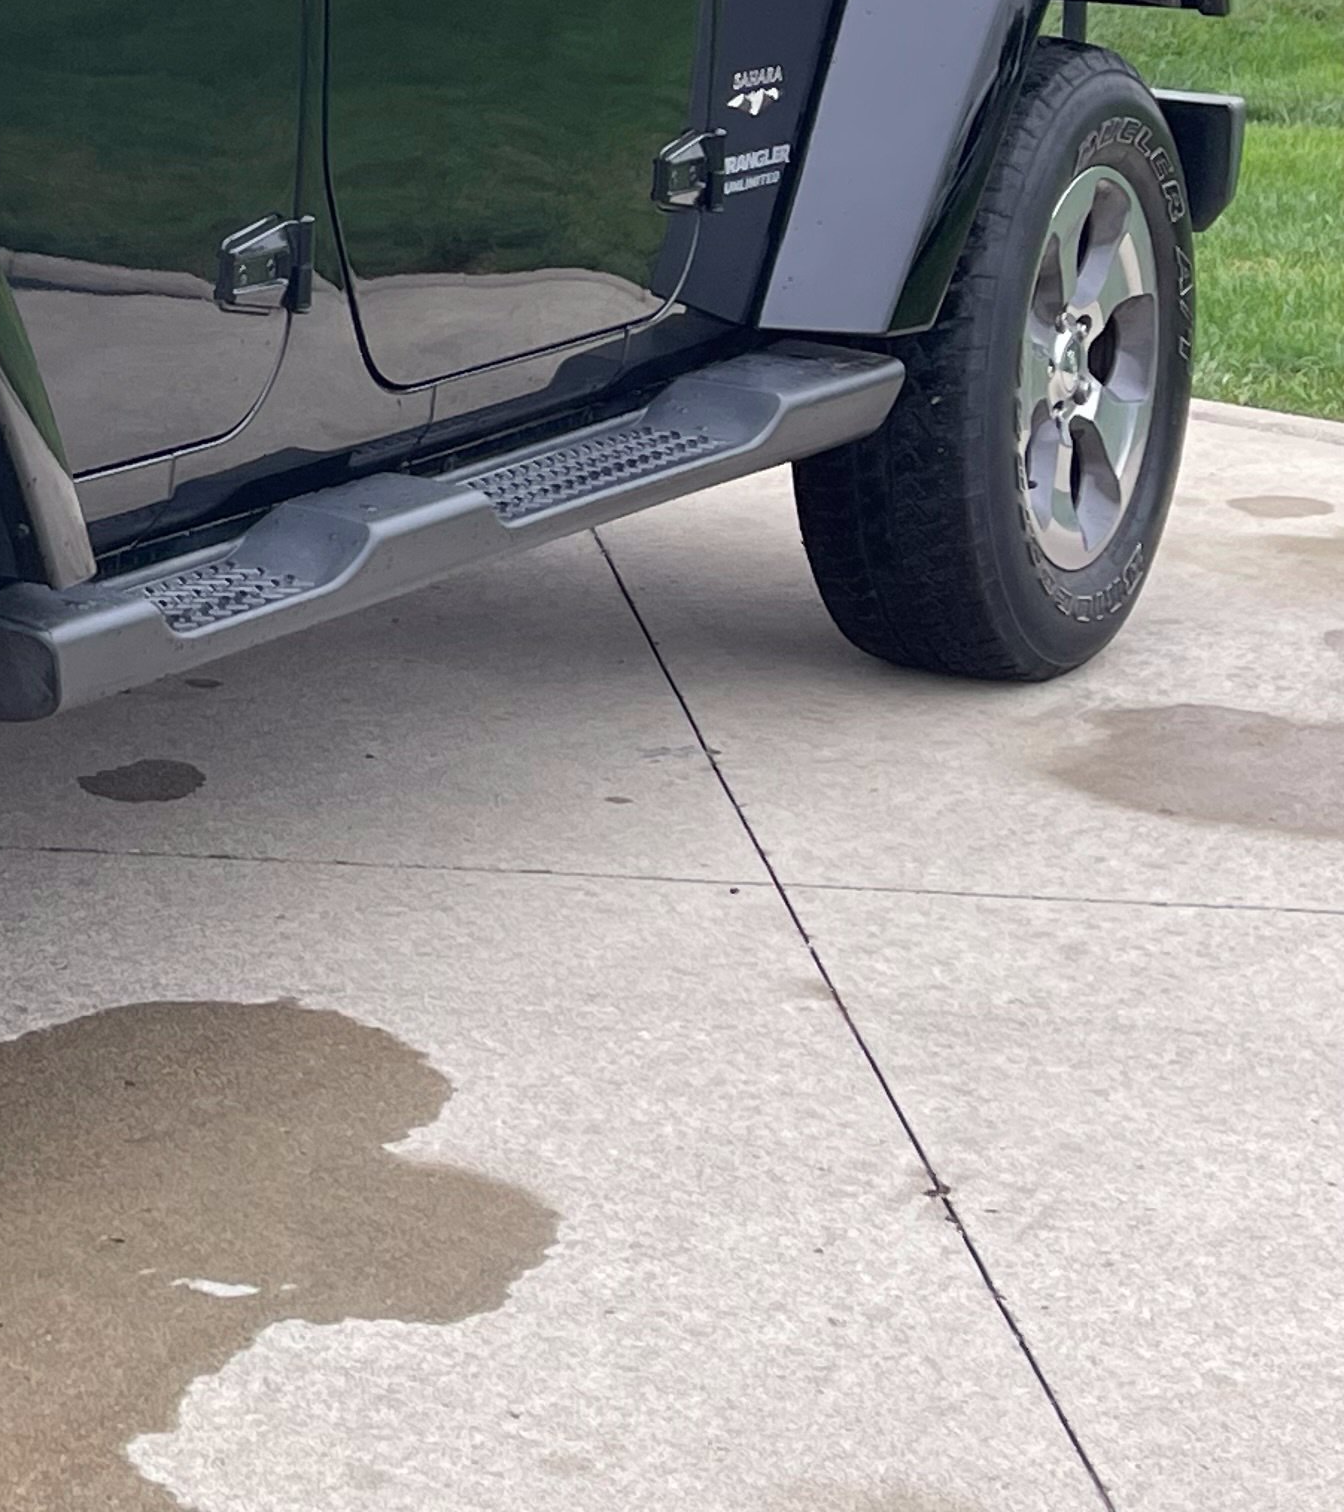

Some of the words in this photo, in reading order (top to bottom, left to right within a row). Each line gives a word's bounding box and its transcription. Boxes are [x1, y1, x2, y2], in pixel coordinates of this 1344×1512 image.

[732, 65, 783, 90] SAHARA
[724, 144, 790, 175] RANGLER
[723, 171, 781, 195] UNLIMITED
